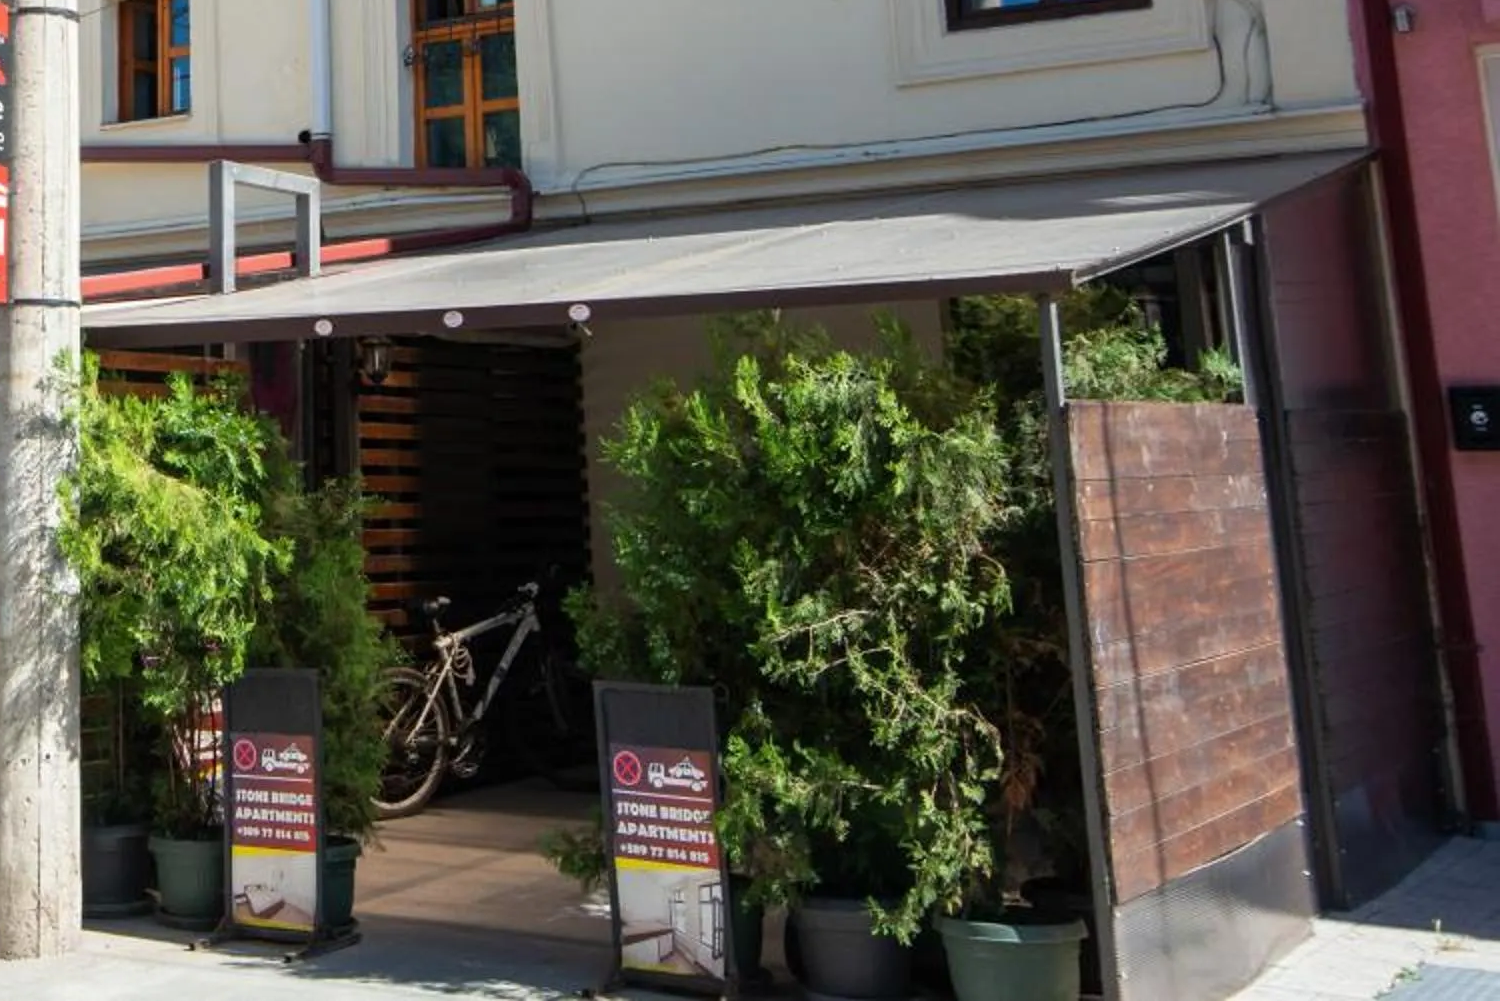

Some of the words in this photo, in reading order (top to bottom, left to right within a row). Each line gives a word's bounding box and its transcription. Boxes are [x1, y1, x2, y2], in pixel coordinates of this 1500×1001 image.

[236, 788, 269, 803] STONE
[271, 791, 313, 806] BRIDGE
[236, 806, 315, 824] APARTMENTS
[617, 801, 657, 818] STONE
[617, 821, 715, 845] APARTMENTS
